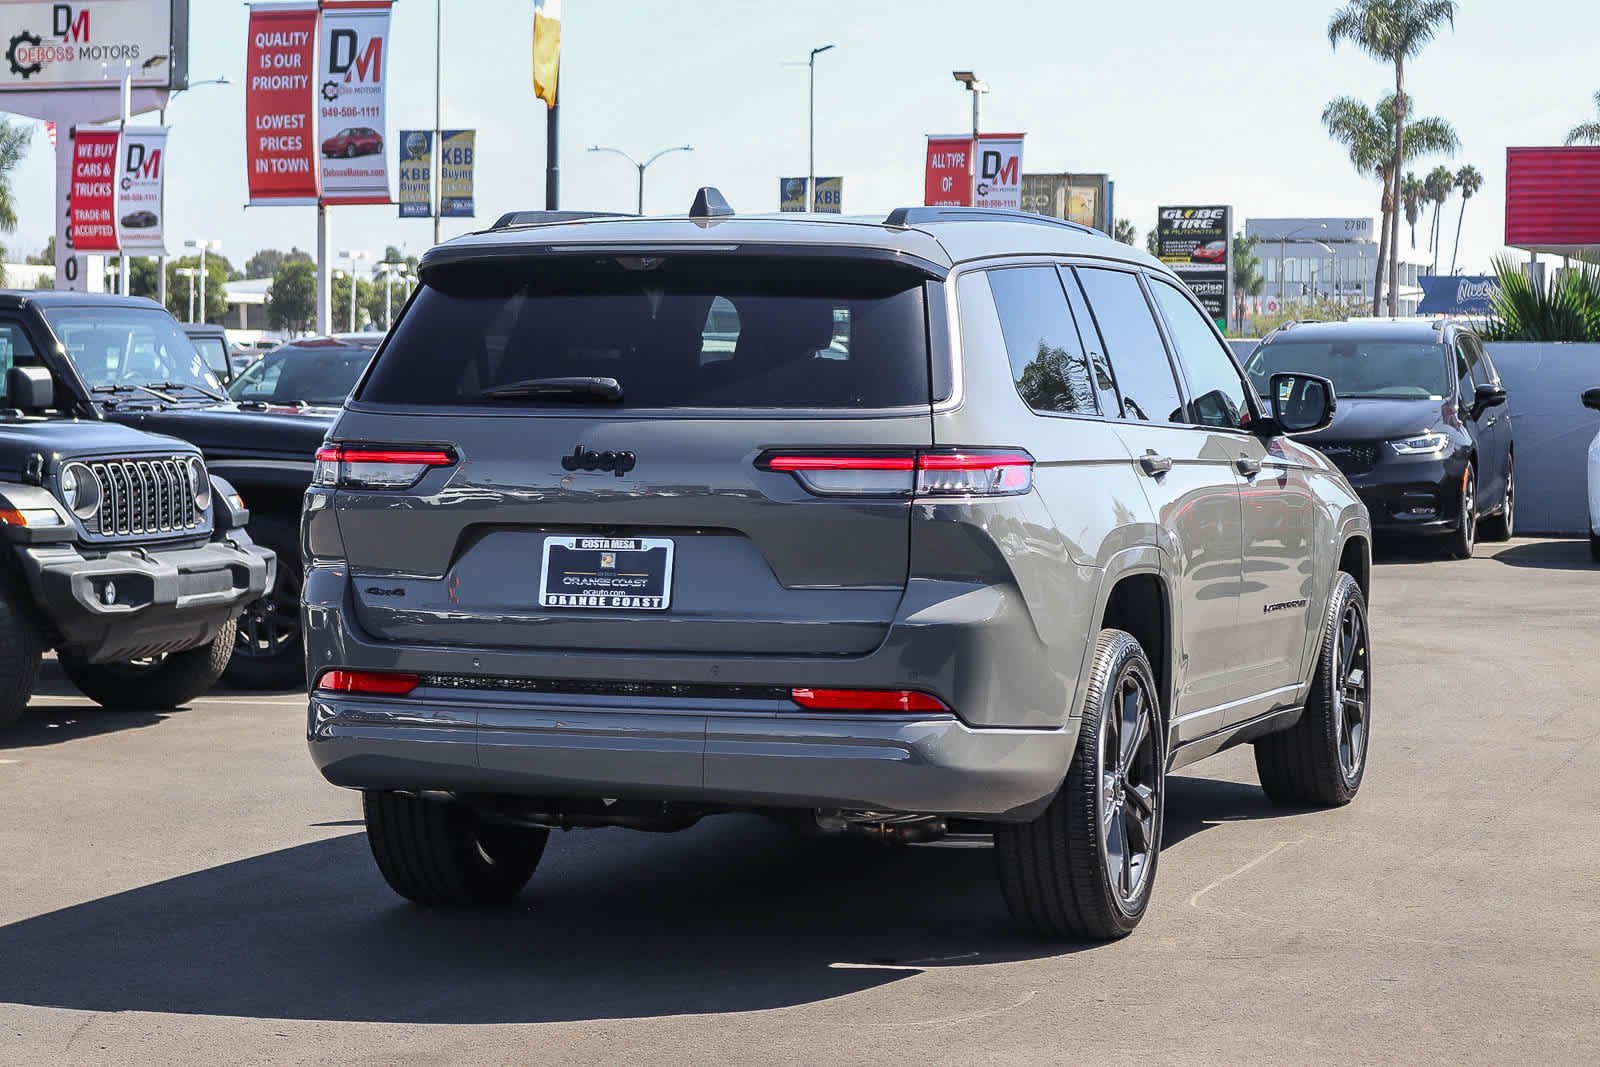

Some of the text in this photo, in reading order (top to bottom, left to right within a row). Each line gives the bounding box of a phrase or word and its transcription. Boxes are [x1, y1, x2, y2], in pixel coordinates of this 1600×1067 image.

[53, 4, 90, 43] DM
[255, 32, 309, 47] QUALITY
[18, 44, 140, 63] DEBOSS MOTORS
[329, 29, 383, 83] DM
[261, 54, 301, 68] IS OUR
[252, 75, 308, 90] PRIORITY
[256, 115, 305, 129] LOWEST
[77, 144, 115, 157] WE BUY
[260, 136, 302, 151] PRICES
[126, 143, 161, 179] DM
[442, 148, 472, 165] KBB
[932, 152, 966, 168] ALL TYPE
[76, 163, 111, 177] CARS &
[256, 158, 309, 173] IN TOWN
[982, 151, 1018, 185] DM
[401, 168, 430, 180] KBB
[75, 182, 112, 196] TRUCKS
[942, 176, 953, 192] OF
[816, 190, 840, 204] KBB
[74, 209, 110, 221] TRADE-IN
[1162, 209, 1224, 219] GLOBE
[74, 224, 113, 237] ACCEPTED
[1172, 219, 1215, 229] TIRE
[561, 444, 636, 477] Jeep
[582, 539, 635, 549] COSTA MESA
[563, 577, 648, 587] ORANGE COAST
[367, 587, 406, 597] 4x4
[548, 595, 661, 608] ORANGE COAST
